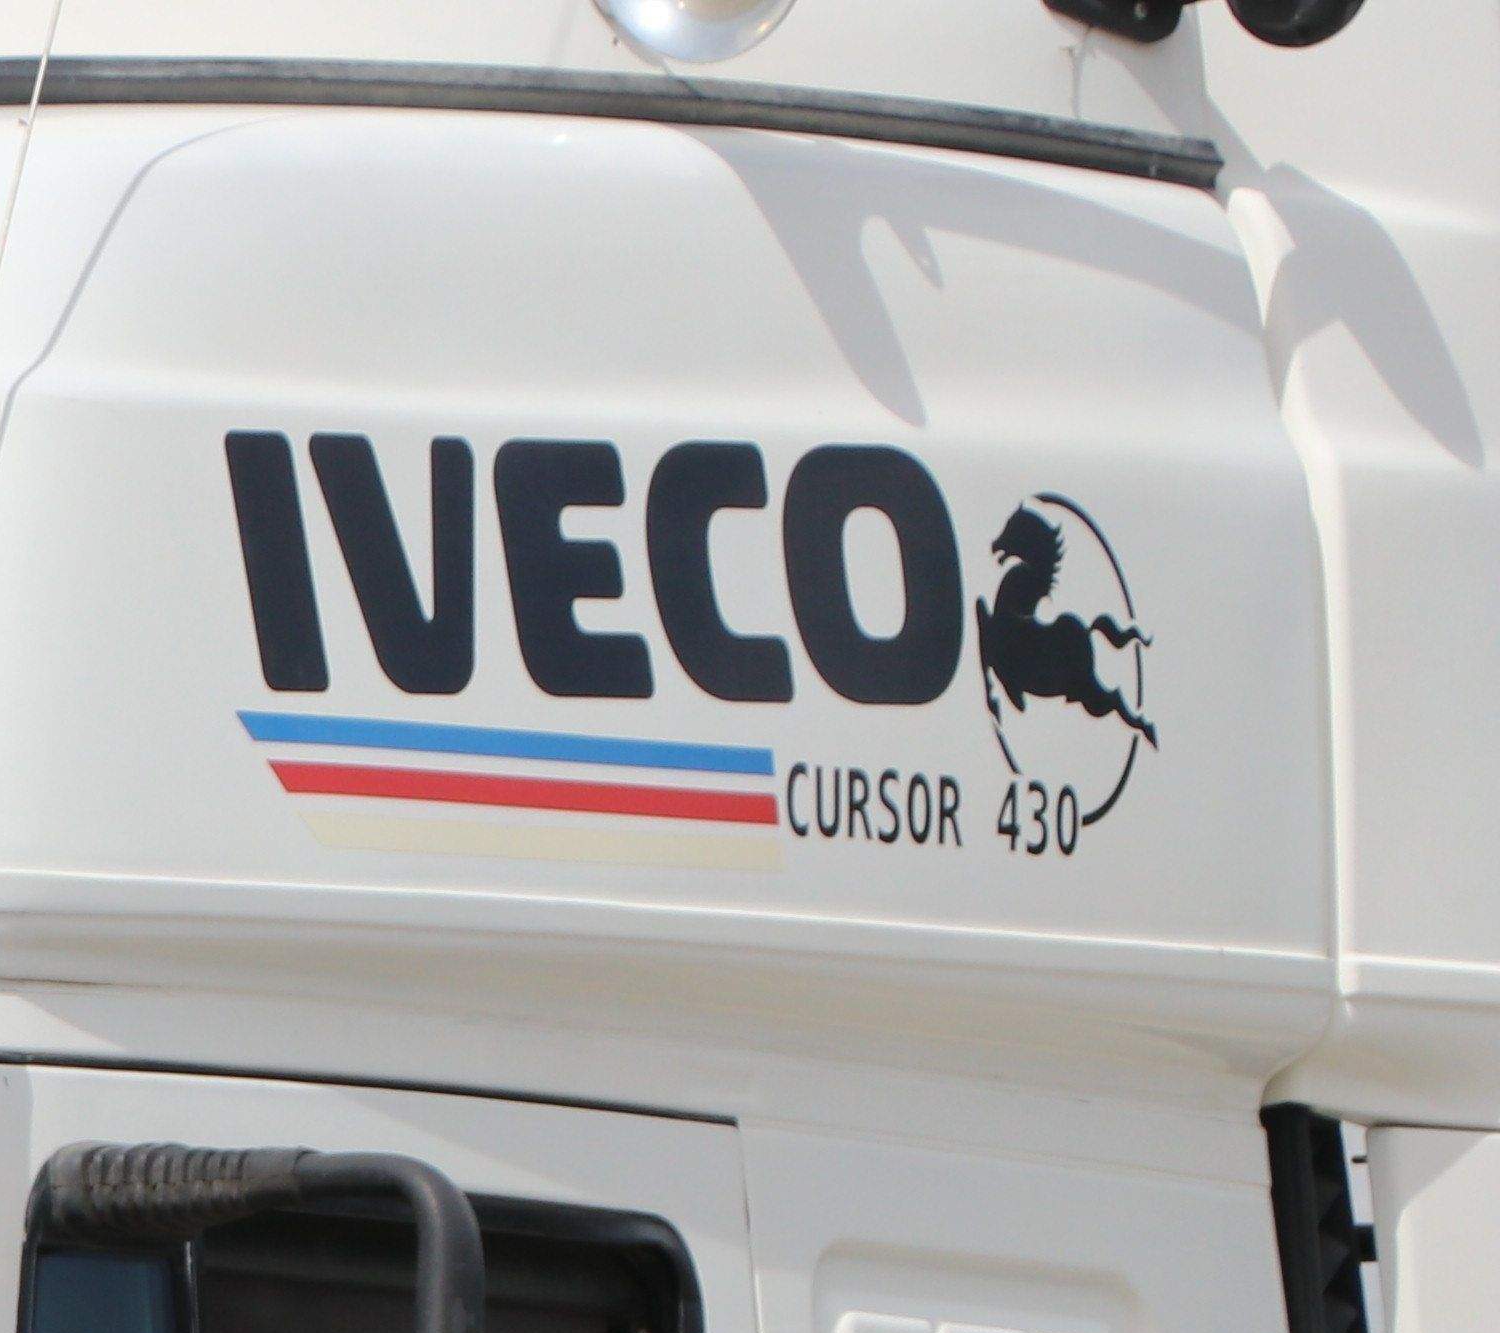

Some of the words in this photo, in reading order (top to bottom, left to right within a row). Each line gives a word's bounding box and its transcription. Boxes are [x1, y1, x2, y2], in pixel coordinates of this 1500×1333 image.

[224, 431, 964, 705] IVECO
[787, 763, 962, 846] CURSOR
[997, 781, 1078, 856] 430
